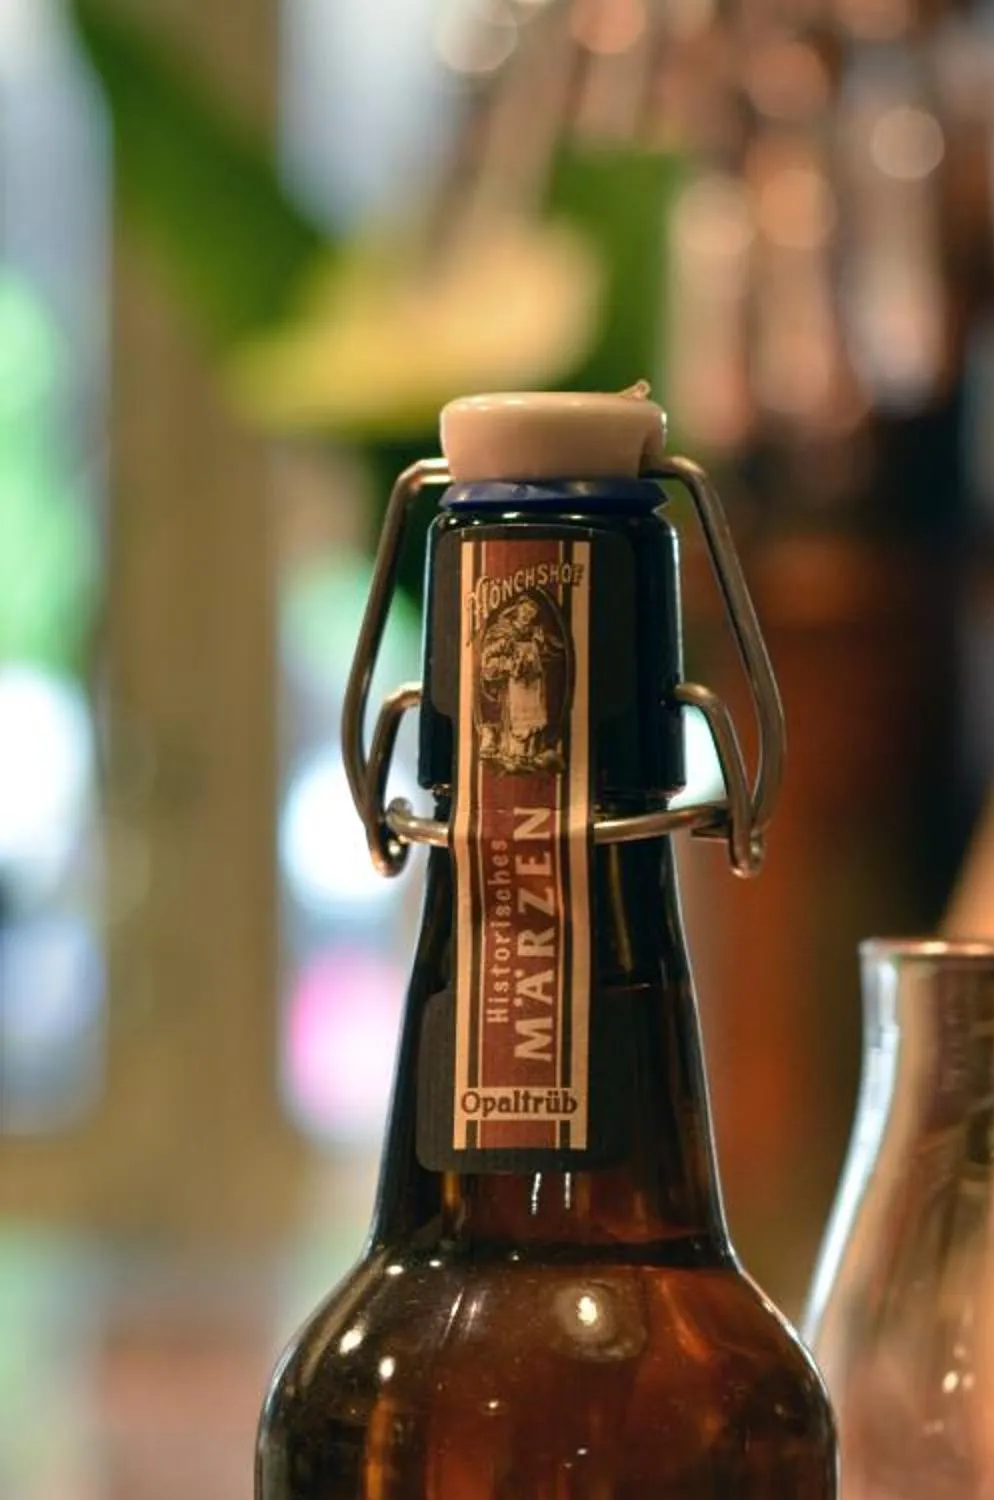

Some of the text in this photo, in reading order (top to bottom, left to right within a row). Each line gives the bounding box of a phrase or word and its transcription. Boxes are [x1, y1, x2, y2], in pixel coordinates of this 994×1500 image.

[466, 562, 585, 646] MÖNCHSHOF
[487, 839, 511, 1024] Historisches
[514, 807, 555, 1062] MÄRZEN
[461, 1089, 578, 1116] Opaltrüb
